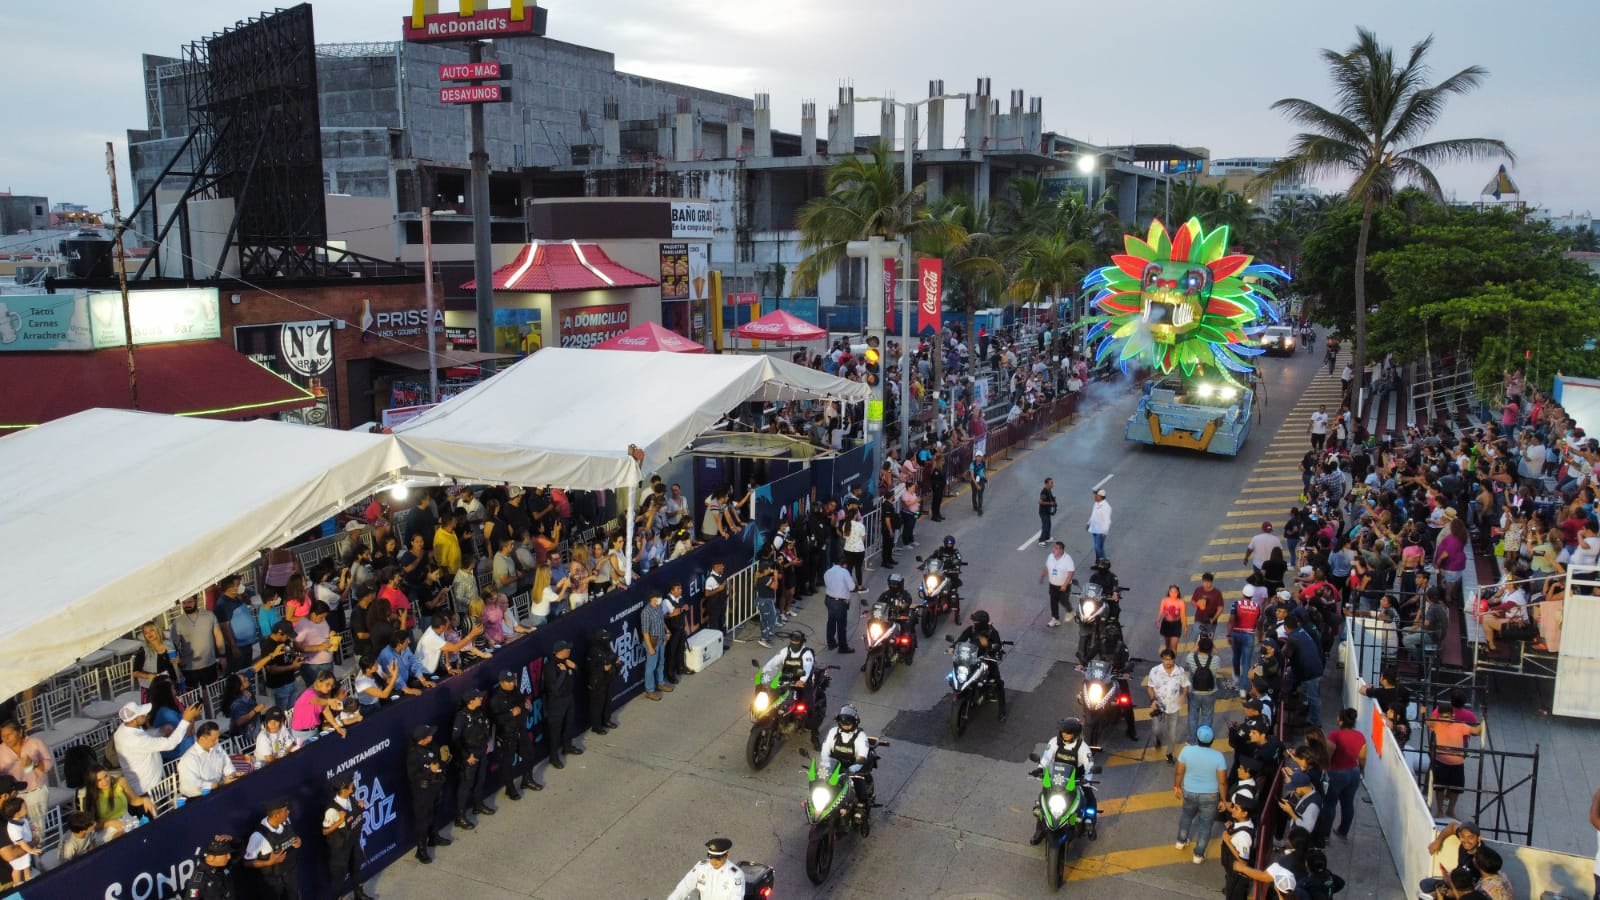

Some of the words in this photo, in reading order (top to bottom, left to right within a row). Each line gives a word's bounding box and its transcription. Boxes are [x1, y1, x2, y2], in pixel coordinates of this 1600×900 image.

[428, 17, 507, 35] McDonald's
[442, 64, 498, 78] AUTO-MAC
[442, 87, 498, 101] DESAYUNOS
[672, 204, 696, 222] BAÑO
[922, 269, 938, 315] Coca-Cola
[31, 307, 54, 316] Tacos
[564, 317, 571, 328] A
[575, 311, 627, 328] DOMICILIO
[28, 319, 58, 328] Carnes
[23, 331, 66, 341] Arrachera
[689, 577, 701, 597] EL
[327, 770, 335, 779] H.
[336, 738, 391, 776] AYUNTAMIENTO
